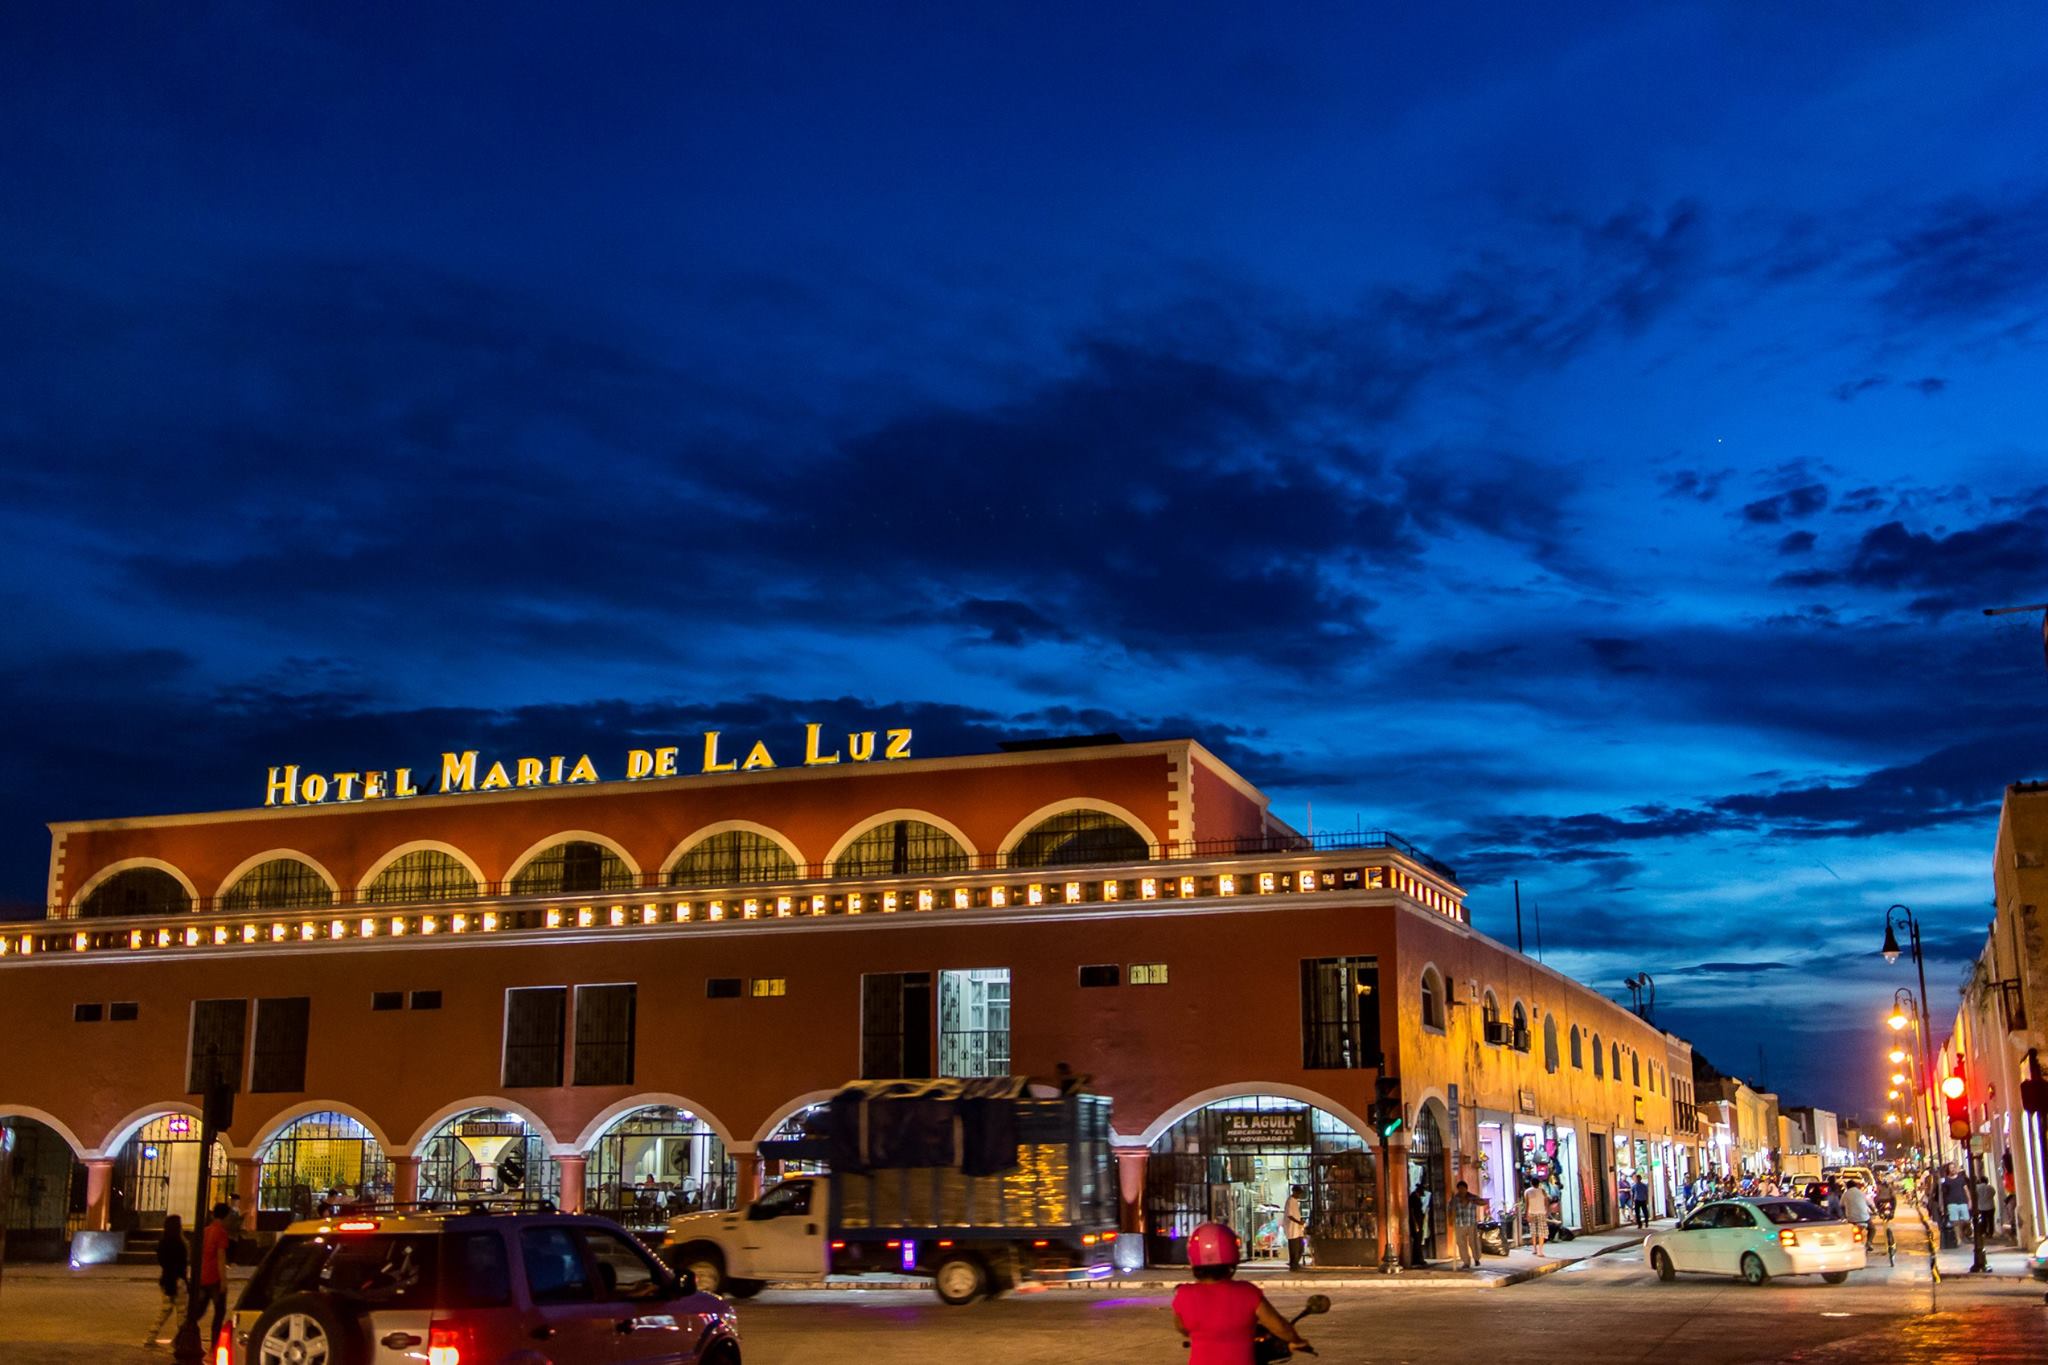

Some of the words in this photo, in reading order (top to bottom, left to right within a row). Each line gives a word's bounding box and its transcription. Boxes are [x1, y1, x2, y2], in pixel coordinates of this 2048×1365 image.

[264, 764, 418, 807] HOTEL
[438, 749, 599, 793] MARIA
[626, 747, 678, 779] DE
[702, 731, 777, 773] LA
[804, 723, 912, 765] LUZ
